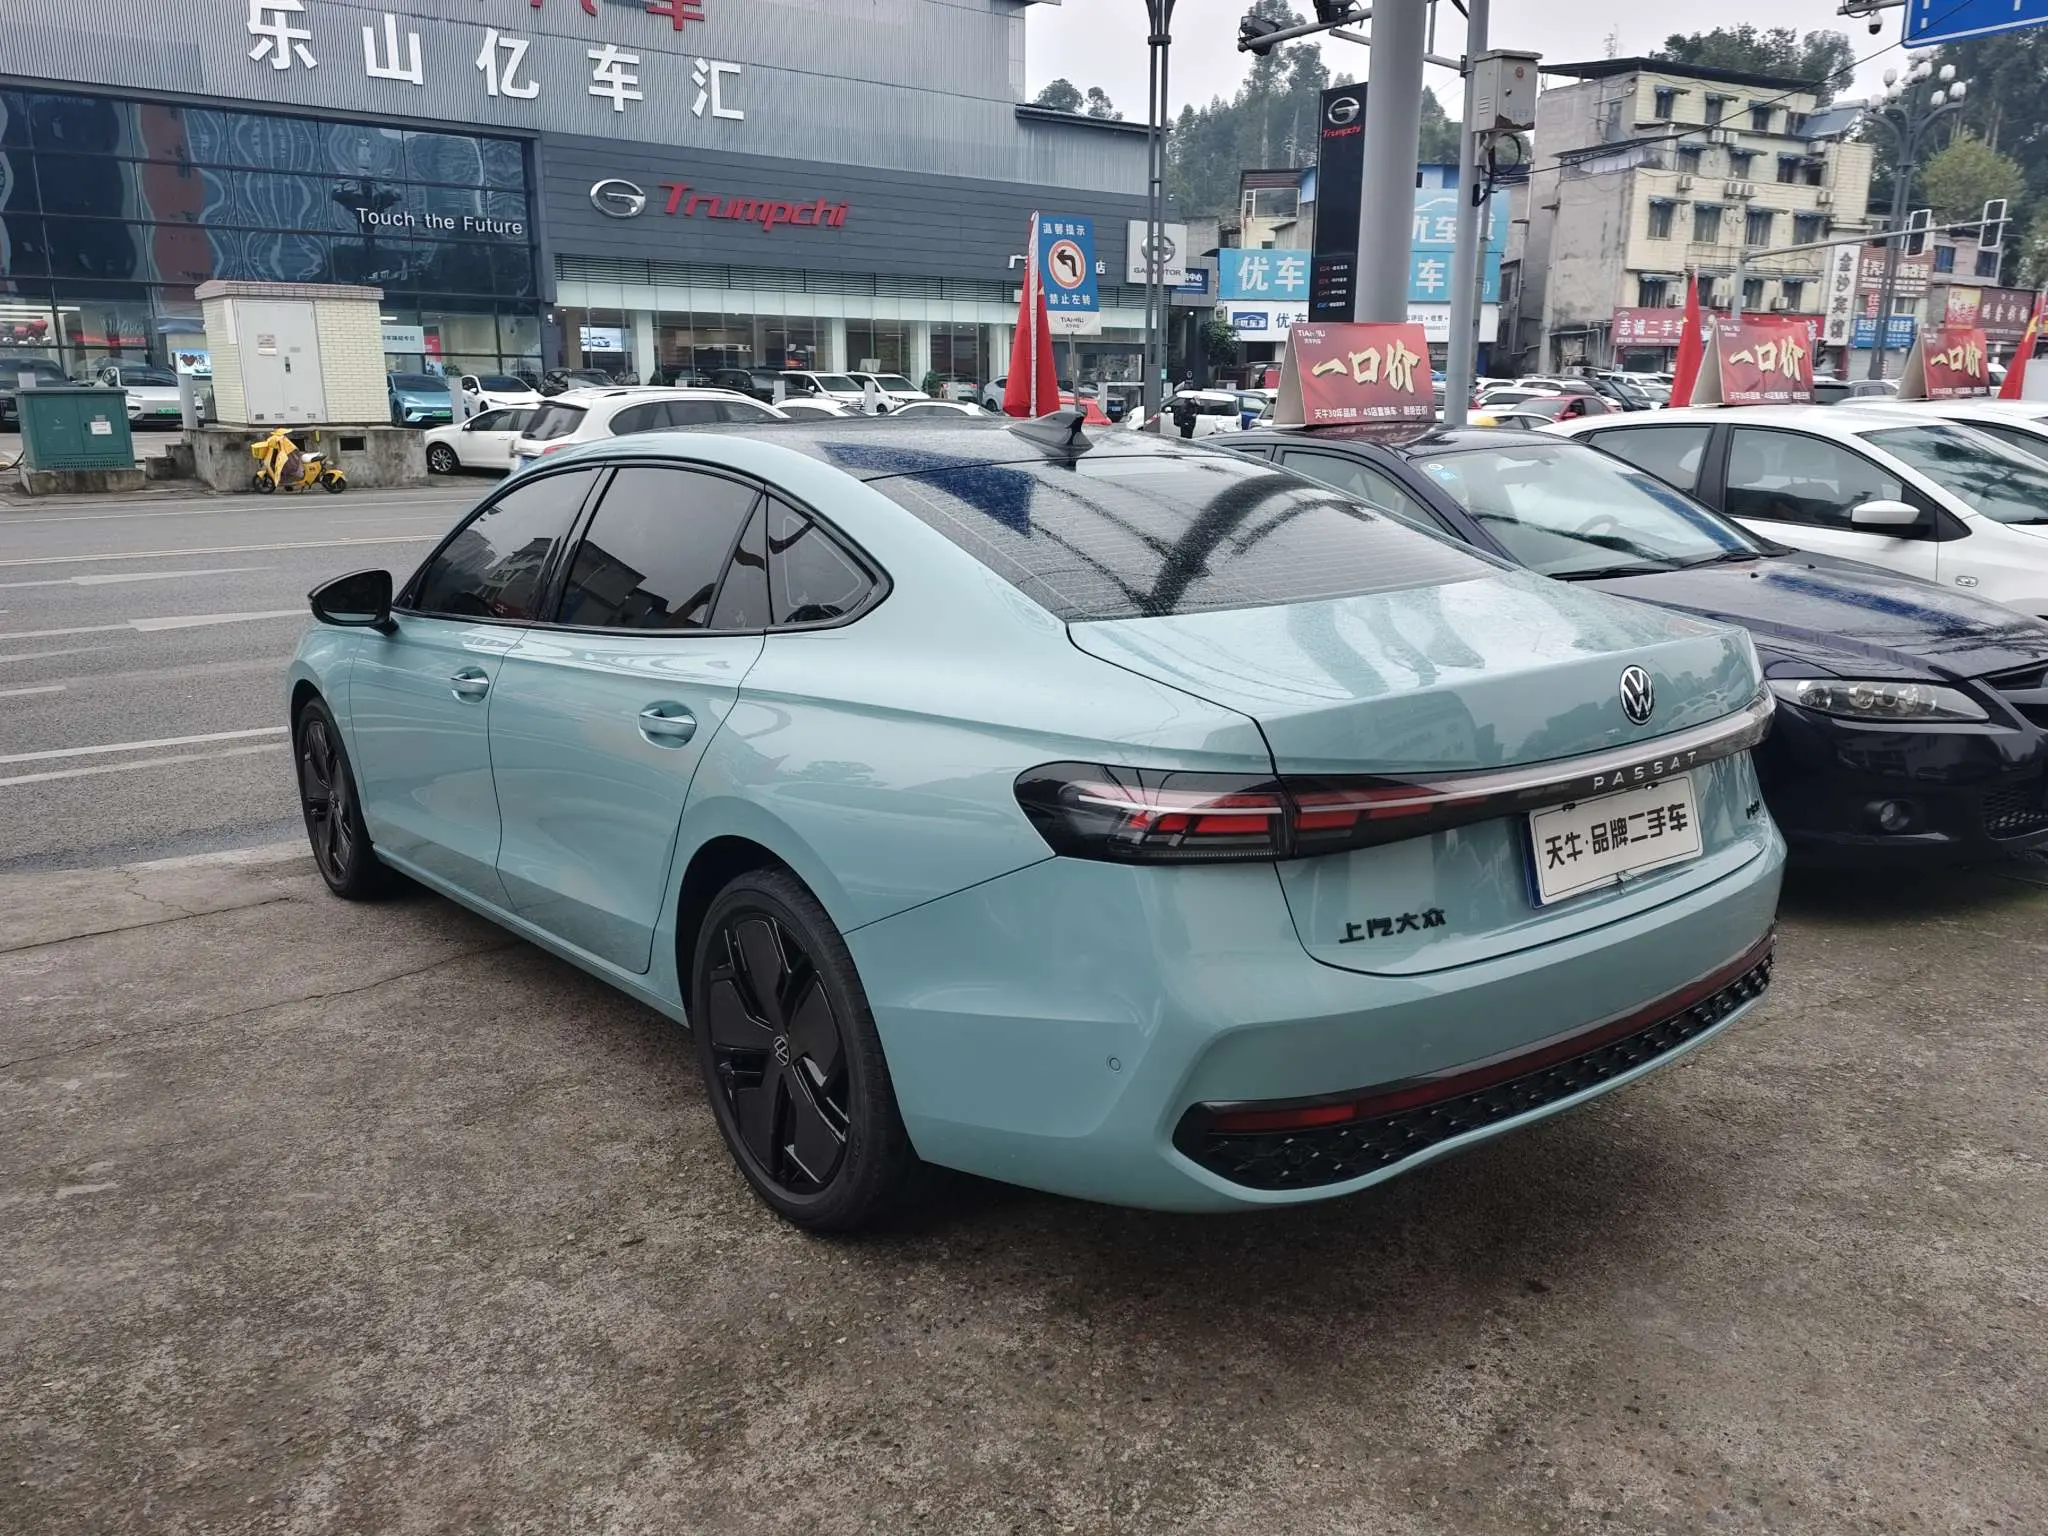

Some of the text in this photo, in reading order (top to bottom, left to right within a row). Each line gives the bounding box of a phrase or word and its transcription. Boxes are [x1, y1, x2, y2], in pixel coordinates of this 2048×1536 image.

[247, 0, 745, 121] 乐山亿车汇
[356, 207, 523, 234] Touch the Future
[660, 180, 848, 232] Trumpchi
[1238, 255, 1306, 293] 优车
[1312, 339, 1421, 395] 一口价
[1729, 336, 1805, 382] 一口价
[1930, 341, 1983, 380] 一口价
[1593, 751, 1697, 791] PASSAT
[1338, 907, 1447, 944] 上汽大众
